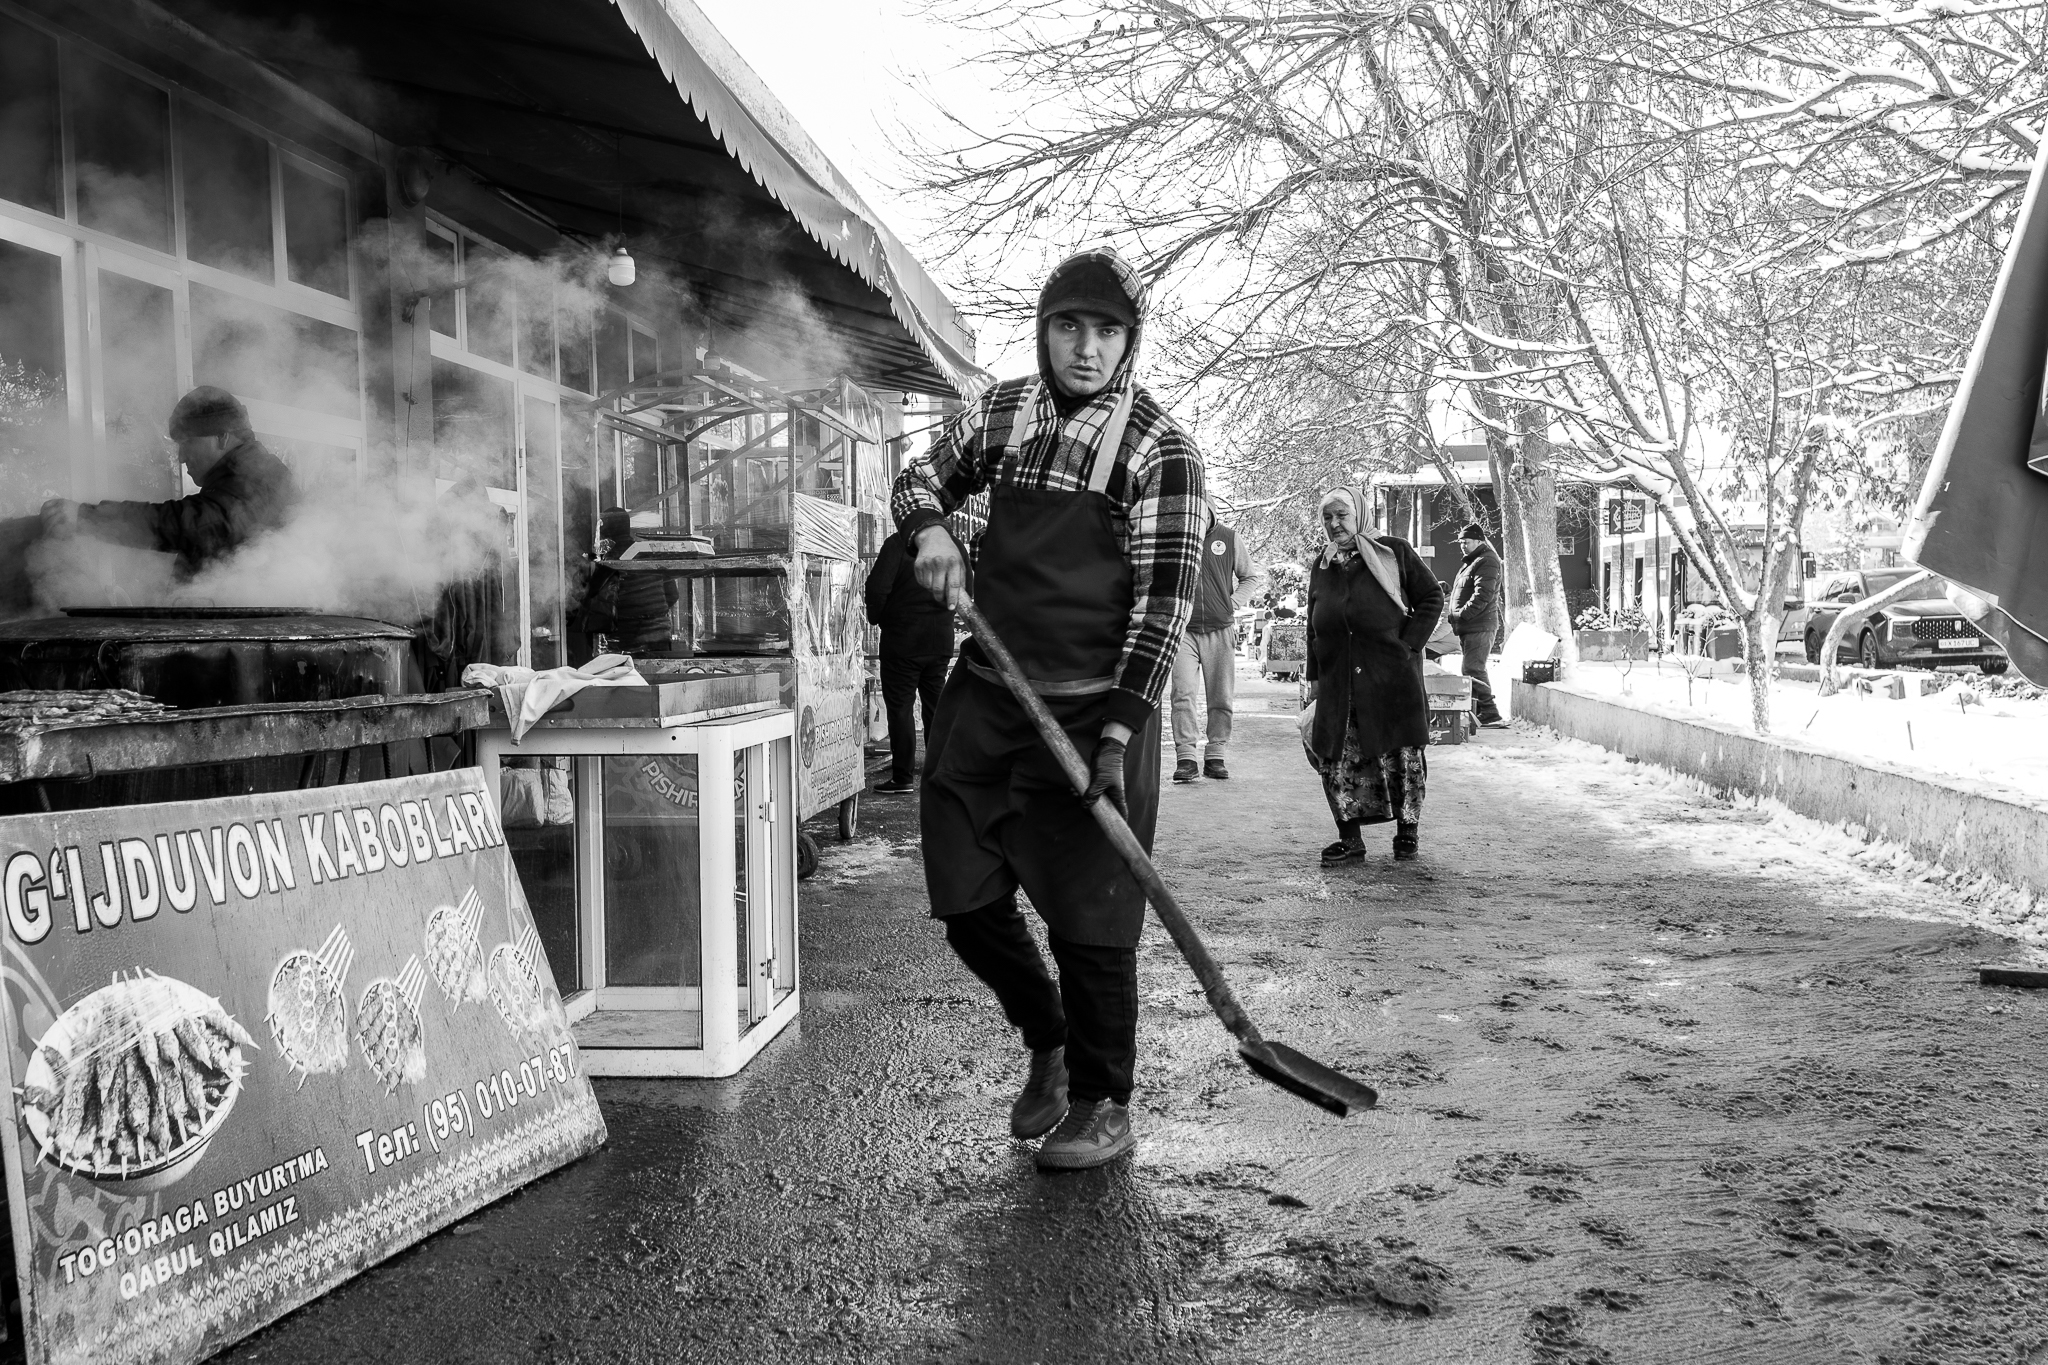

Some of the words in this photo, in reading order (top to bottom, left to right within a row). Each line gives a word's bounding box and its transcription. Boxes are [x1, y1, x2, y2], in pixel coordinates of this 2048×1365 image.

[298, 791, 503, 884] KABOBLARI
[355, 1121, 420, 1174] Тел:
[423, 1088, 474, 1153] (95)
[474, 1042, 576, 1119] 010-07-87
[213, 1147, 330, 1218] BUYURTMA
[119, 1243, 203, 1301] QABUL
[209, 1195, 300, 1258] QILAMIZ
